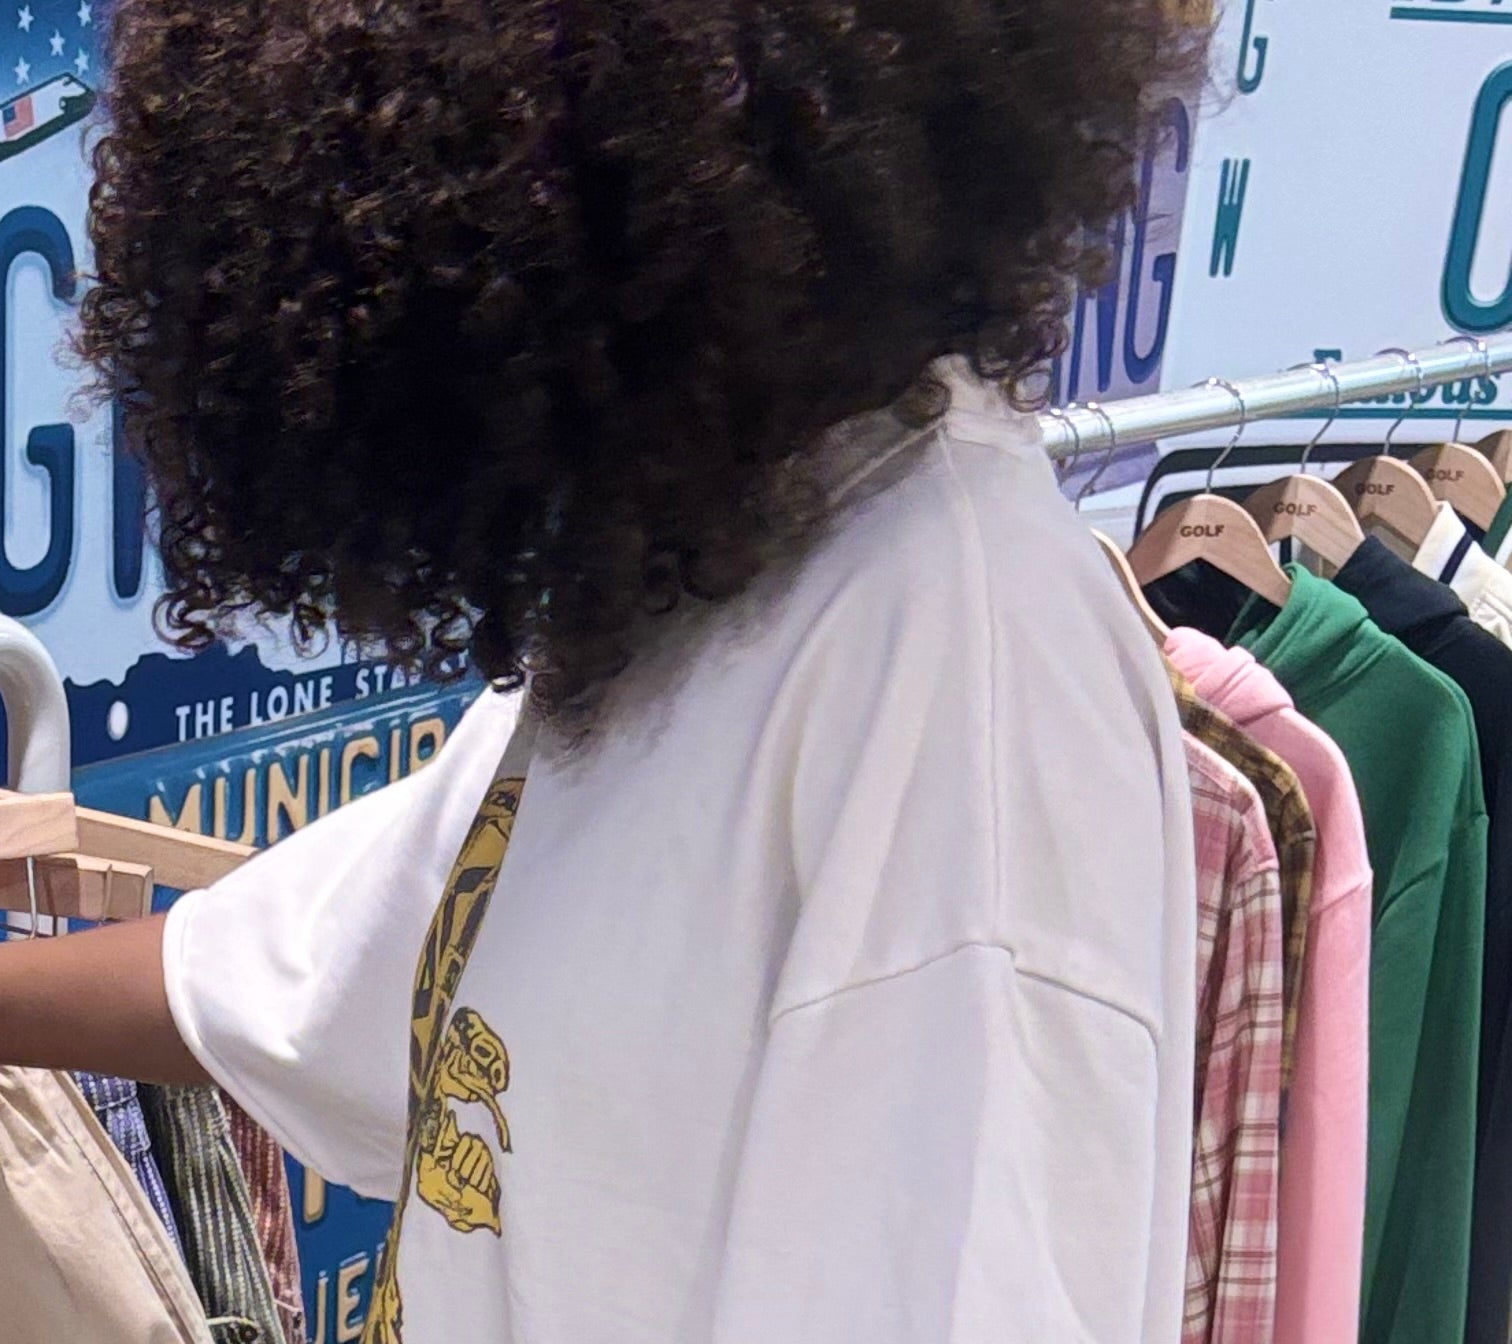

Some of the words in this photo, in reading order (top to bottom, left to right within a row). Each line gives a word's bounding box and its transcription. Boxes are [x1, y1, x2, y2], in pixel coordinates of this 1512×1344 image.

[1425, 467, 1465, 482] GOLF
[1354, 482, 1395, 496] GOLF
[1273, 501, 1318, 517] GOLF
[1179, 524, 1225, 539] GOLF
[175, 696, 234, 742] THE
[249, 676, 334, 727] LONE
